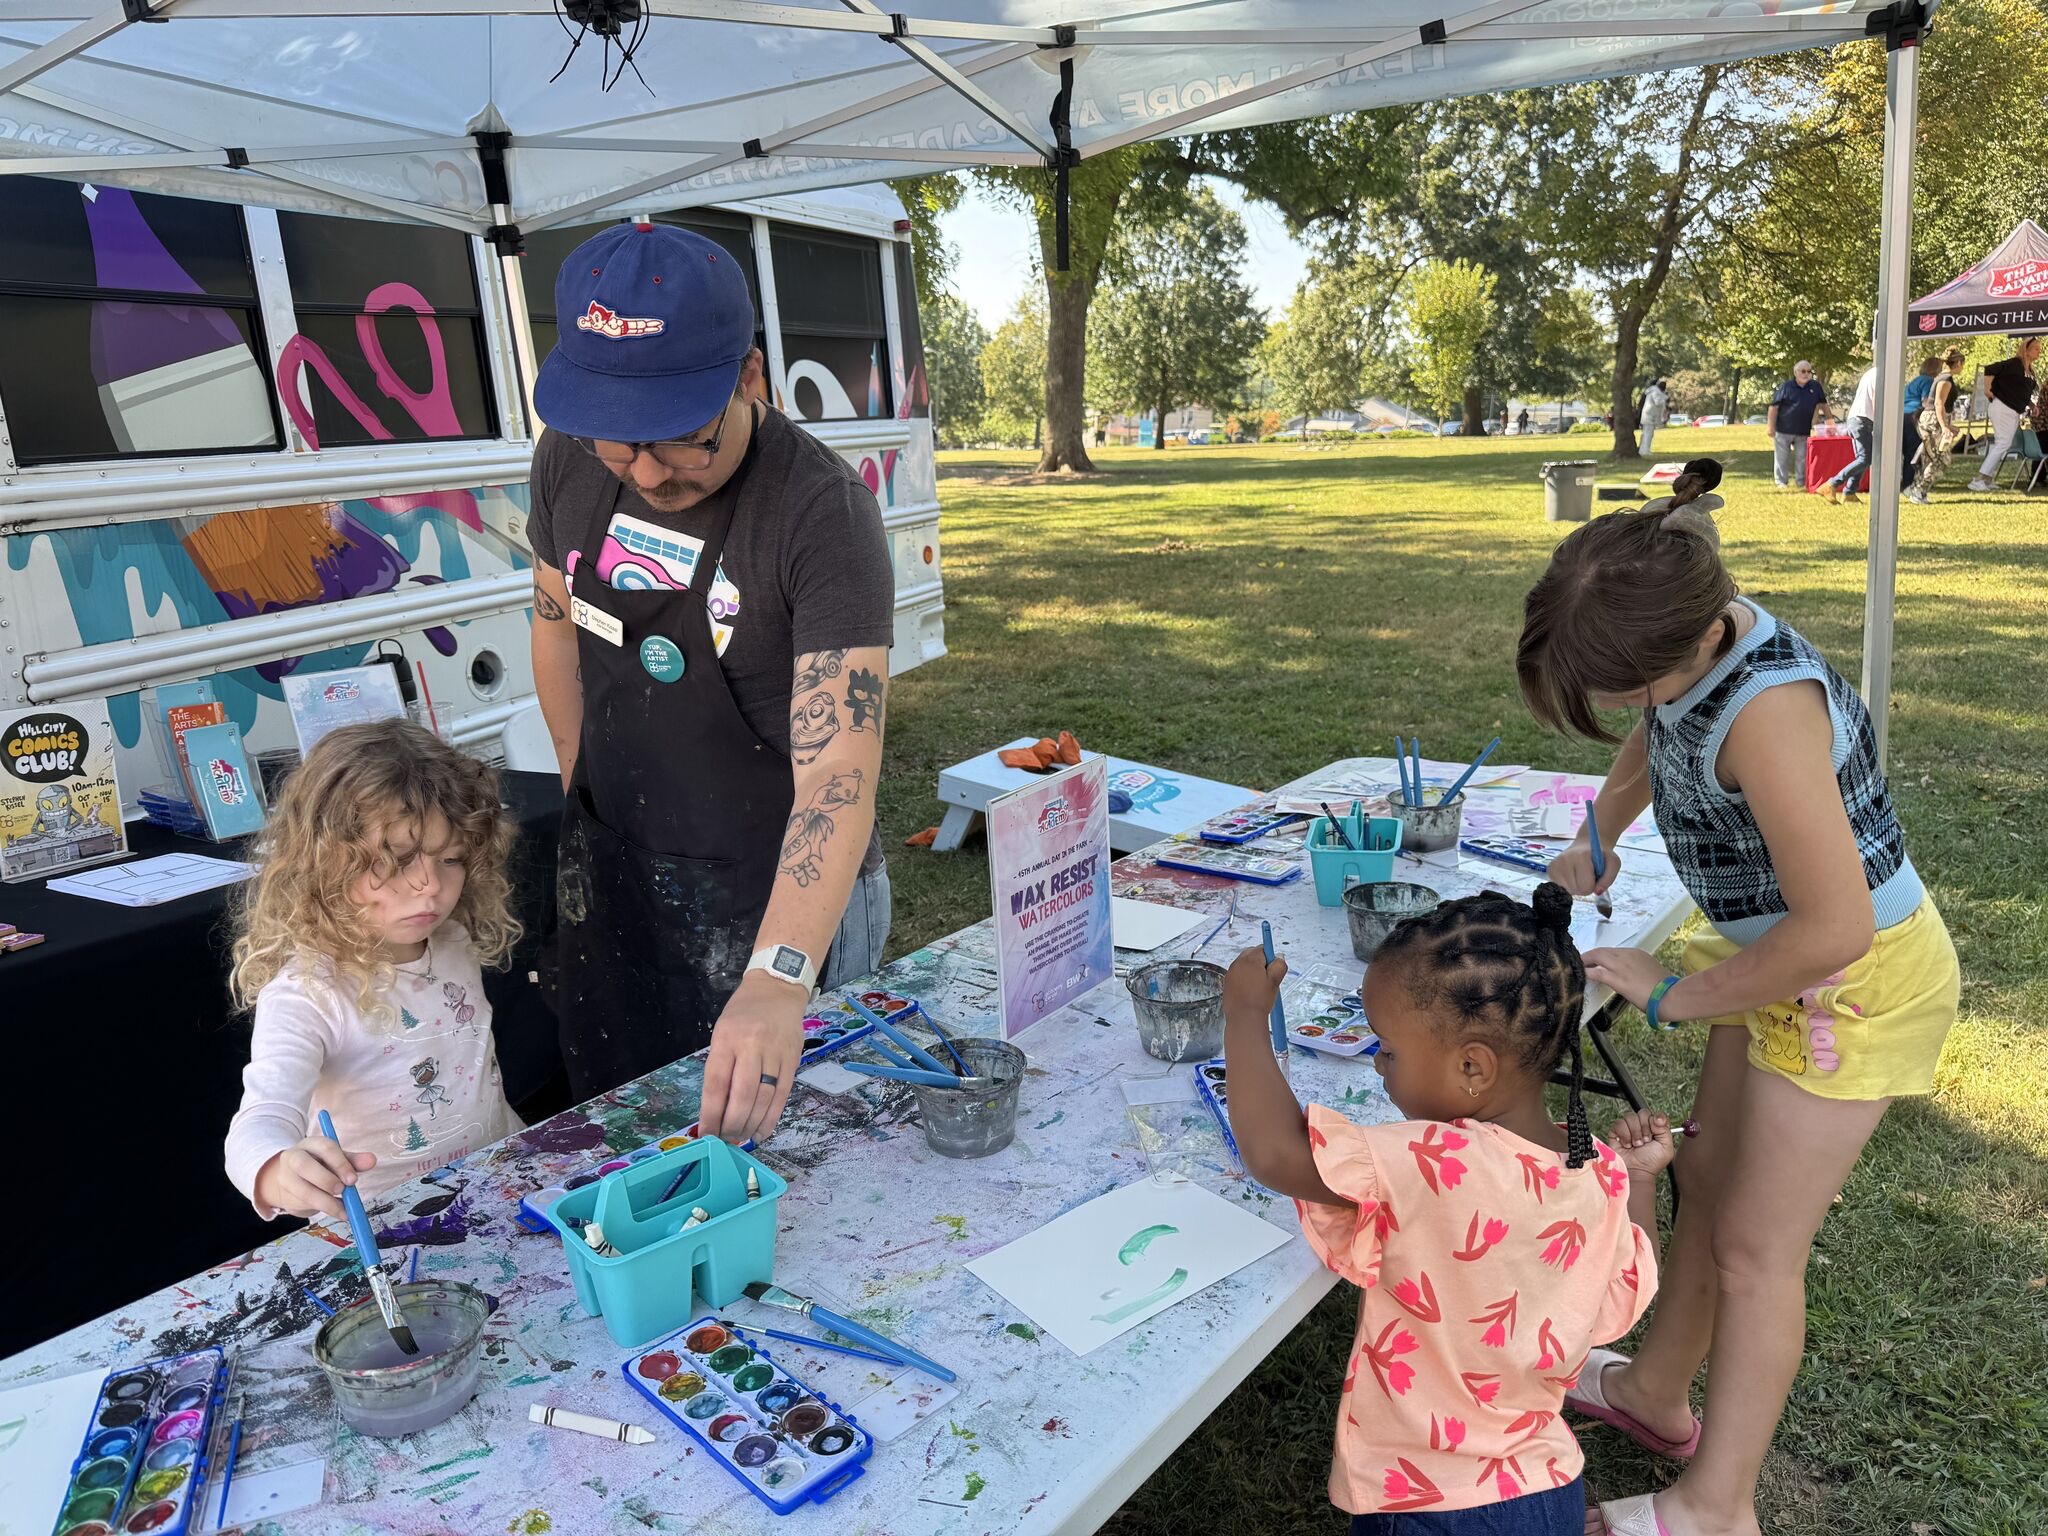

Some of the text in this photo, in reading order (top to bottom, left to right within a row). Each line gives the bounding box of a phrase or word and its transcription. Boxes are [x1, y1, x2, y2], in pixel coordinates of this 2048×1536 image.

[2004, 263, 2037, 281] THE
[1942, 313, 1998, 328] DOING
[2002, 310, 2034, 324] THE
[171, 712, 191, 721] THE
[174, 719, 198, 730] ARTS
[18, 722, 67, 737] HILL CITY
[8, 731, 80, 757] COMICS
[15, 750, 77, 774] CLUB!
[1032, 859, 1051, 872] ANNUAL
[1051, 854, 1061, 863] DAY
[1062, 850, 1067, 858] IN
[1076, 840, 1088, 851] PARK
[1010, 853, 1098, 916] WAX RESIST
[1018, 880, 1094, 930] WATERCOLORS
[1025, 939, 1034, 949] USE
[1034, 933, 1044, 944] THE
[1044, 923, 1066, 938] CRAYONS
[1067, 919, 1073, 927] TO
[1027, 949, 1035, 957] AN
[1051, 936, 1059, 944] OR
[1059, 929, 1071, 941] MAKE
[1046, 945, 1059, 957] PAINT
[1060, 938, 1072, 949] OVER
[1064, 948, 1070, 956] TO
